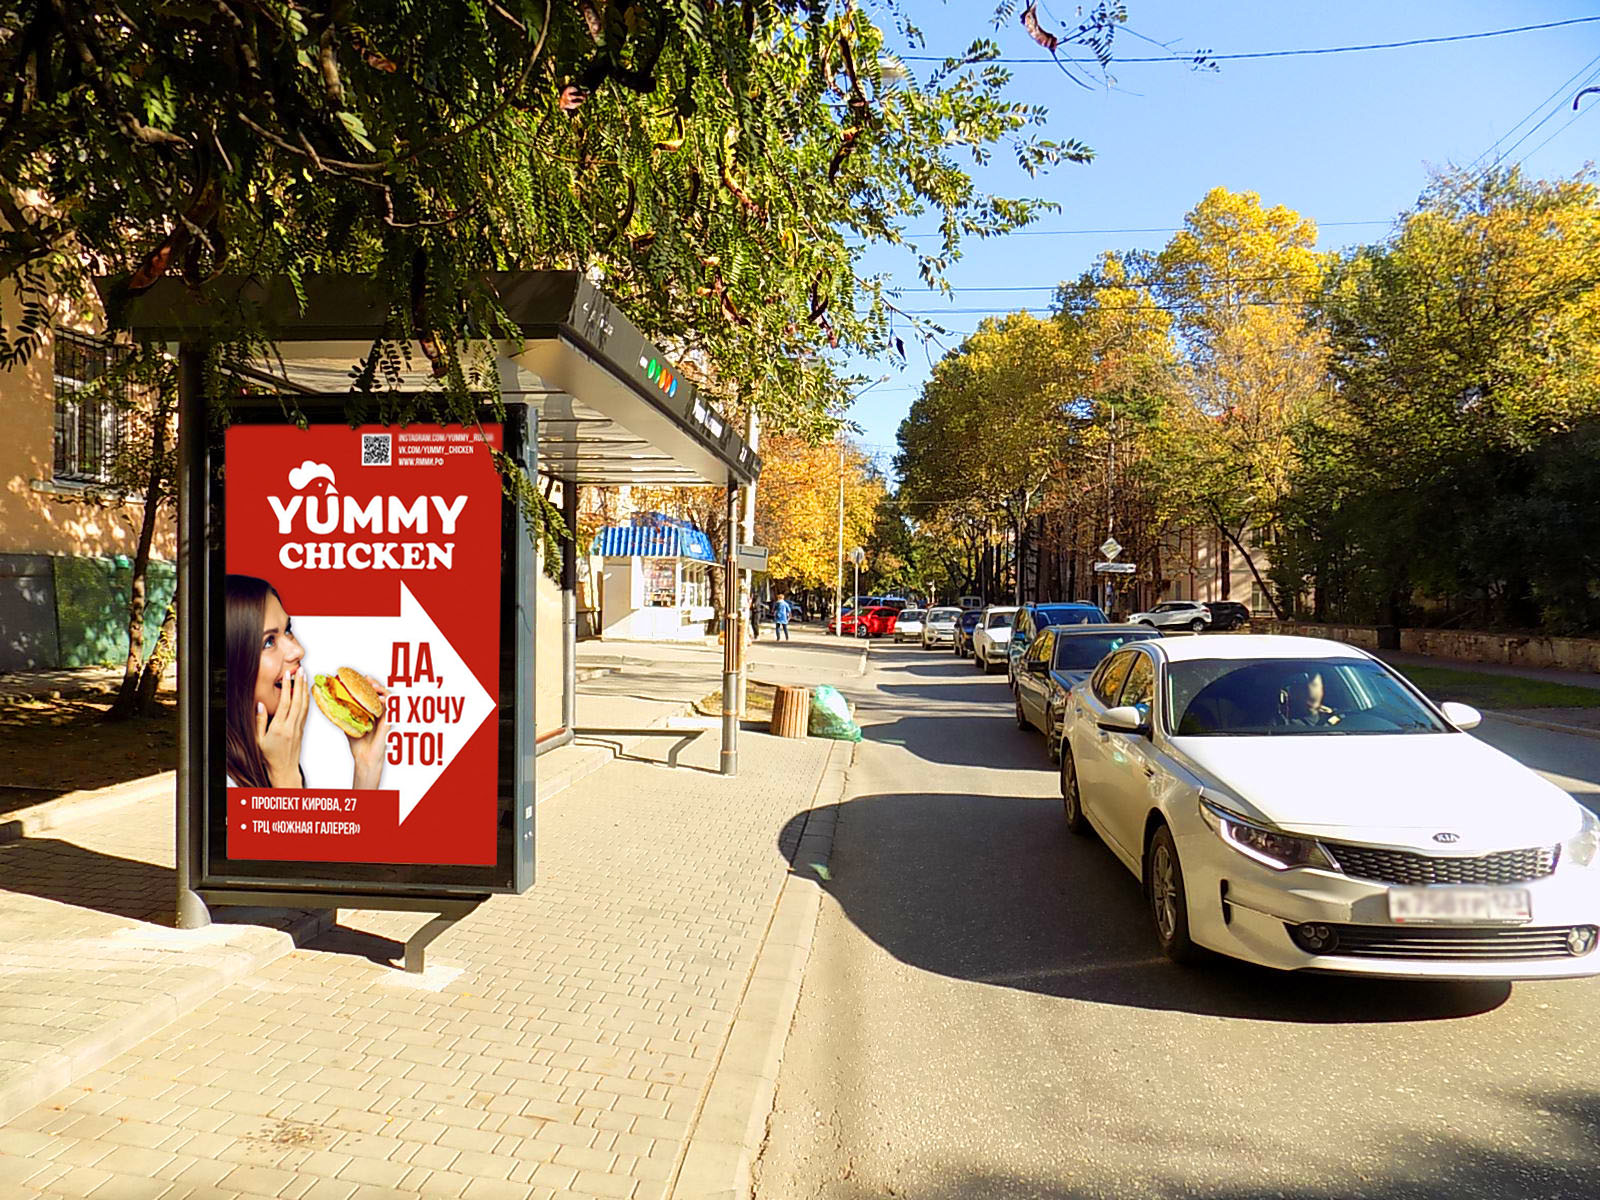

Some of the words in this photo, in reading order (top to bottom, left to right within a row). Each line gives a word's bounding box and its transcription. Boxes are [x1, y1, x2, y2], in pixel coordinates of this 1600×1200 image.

[266, 495, 469, 535] YUMMY
[278, 542, 456, 570] CHICKEN
[387, 641, 444, 689] ДА,
[387, 695, 401, 723] Я
[406, 695, 466, 724] ХОЧУ
[387, 731, 444, 766] ЭТО!
[251, 796, 300, 811] ПРОСПЕКТ
[301, 798, 342, 812] КИРОВА,
[344, 798, 357, 811] 27
[252, 820, 270, 834] ТРЦ
[271, 820, 314, 834] «ЮЖНАЯ
[314, 821, 360, 835] ГАЛЕРЕЯ»
